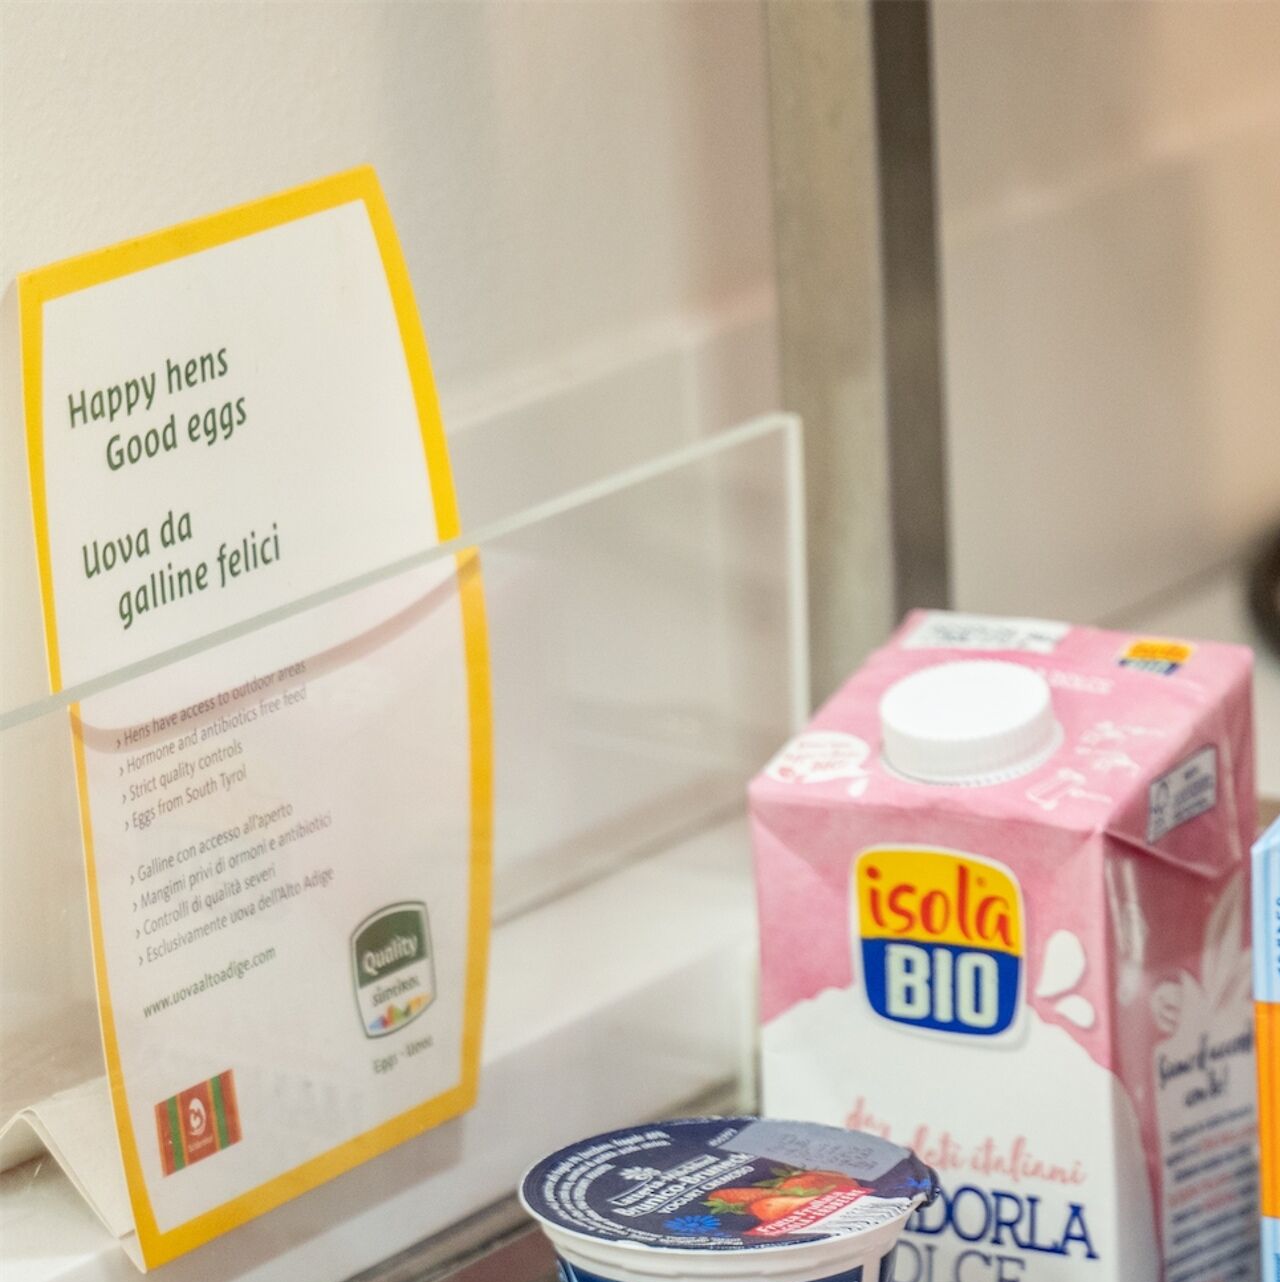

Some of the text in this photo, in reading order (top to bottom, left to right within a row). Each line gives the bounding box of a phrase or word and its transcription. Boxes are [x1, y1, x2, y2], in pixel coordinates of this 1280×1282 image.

[68, 348, 229, 428] Happy hens
[106, 396, 248, 471] Good eggs
[82, 510, 193, 579] Uova da
[118, 523, 281, 630] galline felici
[124, 660, 307, 746] Hens have access to outdoor areas
[127, 684, 307, 774] Hormone and antibiotics free feed
[129, 739, 244, 802] Strict quality controls
[132, 763, 248, 830] Eggs from South Tyrol
[137, 854, 175, 882] Galline
[176, 843, 197, 864] con
[199, 825, 241, 854] accesso
[140, 811, 333, 910] Mangimi privi ormoni antibiotici
[143, 862, 277, 936] Controlli qualità severi
[146, 914, 228, 962] Esclusivamente
[229, 901, 257, 924] uova
[303, 865, 335, 890] Adige
[863, 863, 1015, 949] isola
[143, 946, 277, 1019] www.uovaaltoadige.com
[363, 934, 419, 977] Quality
[884, 941, 1000, 1030] BIO
[702, 1165, 756, 1191] CREMOSO
[970, 1133, 1089, 1188] italiani
